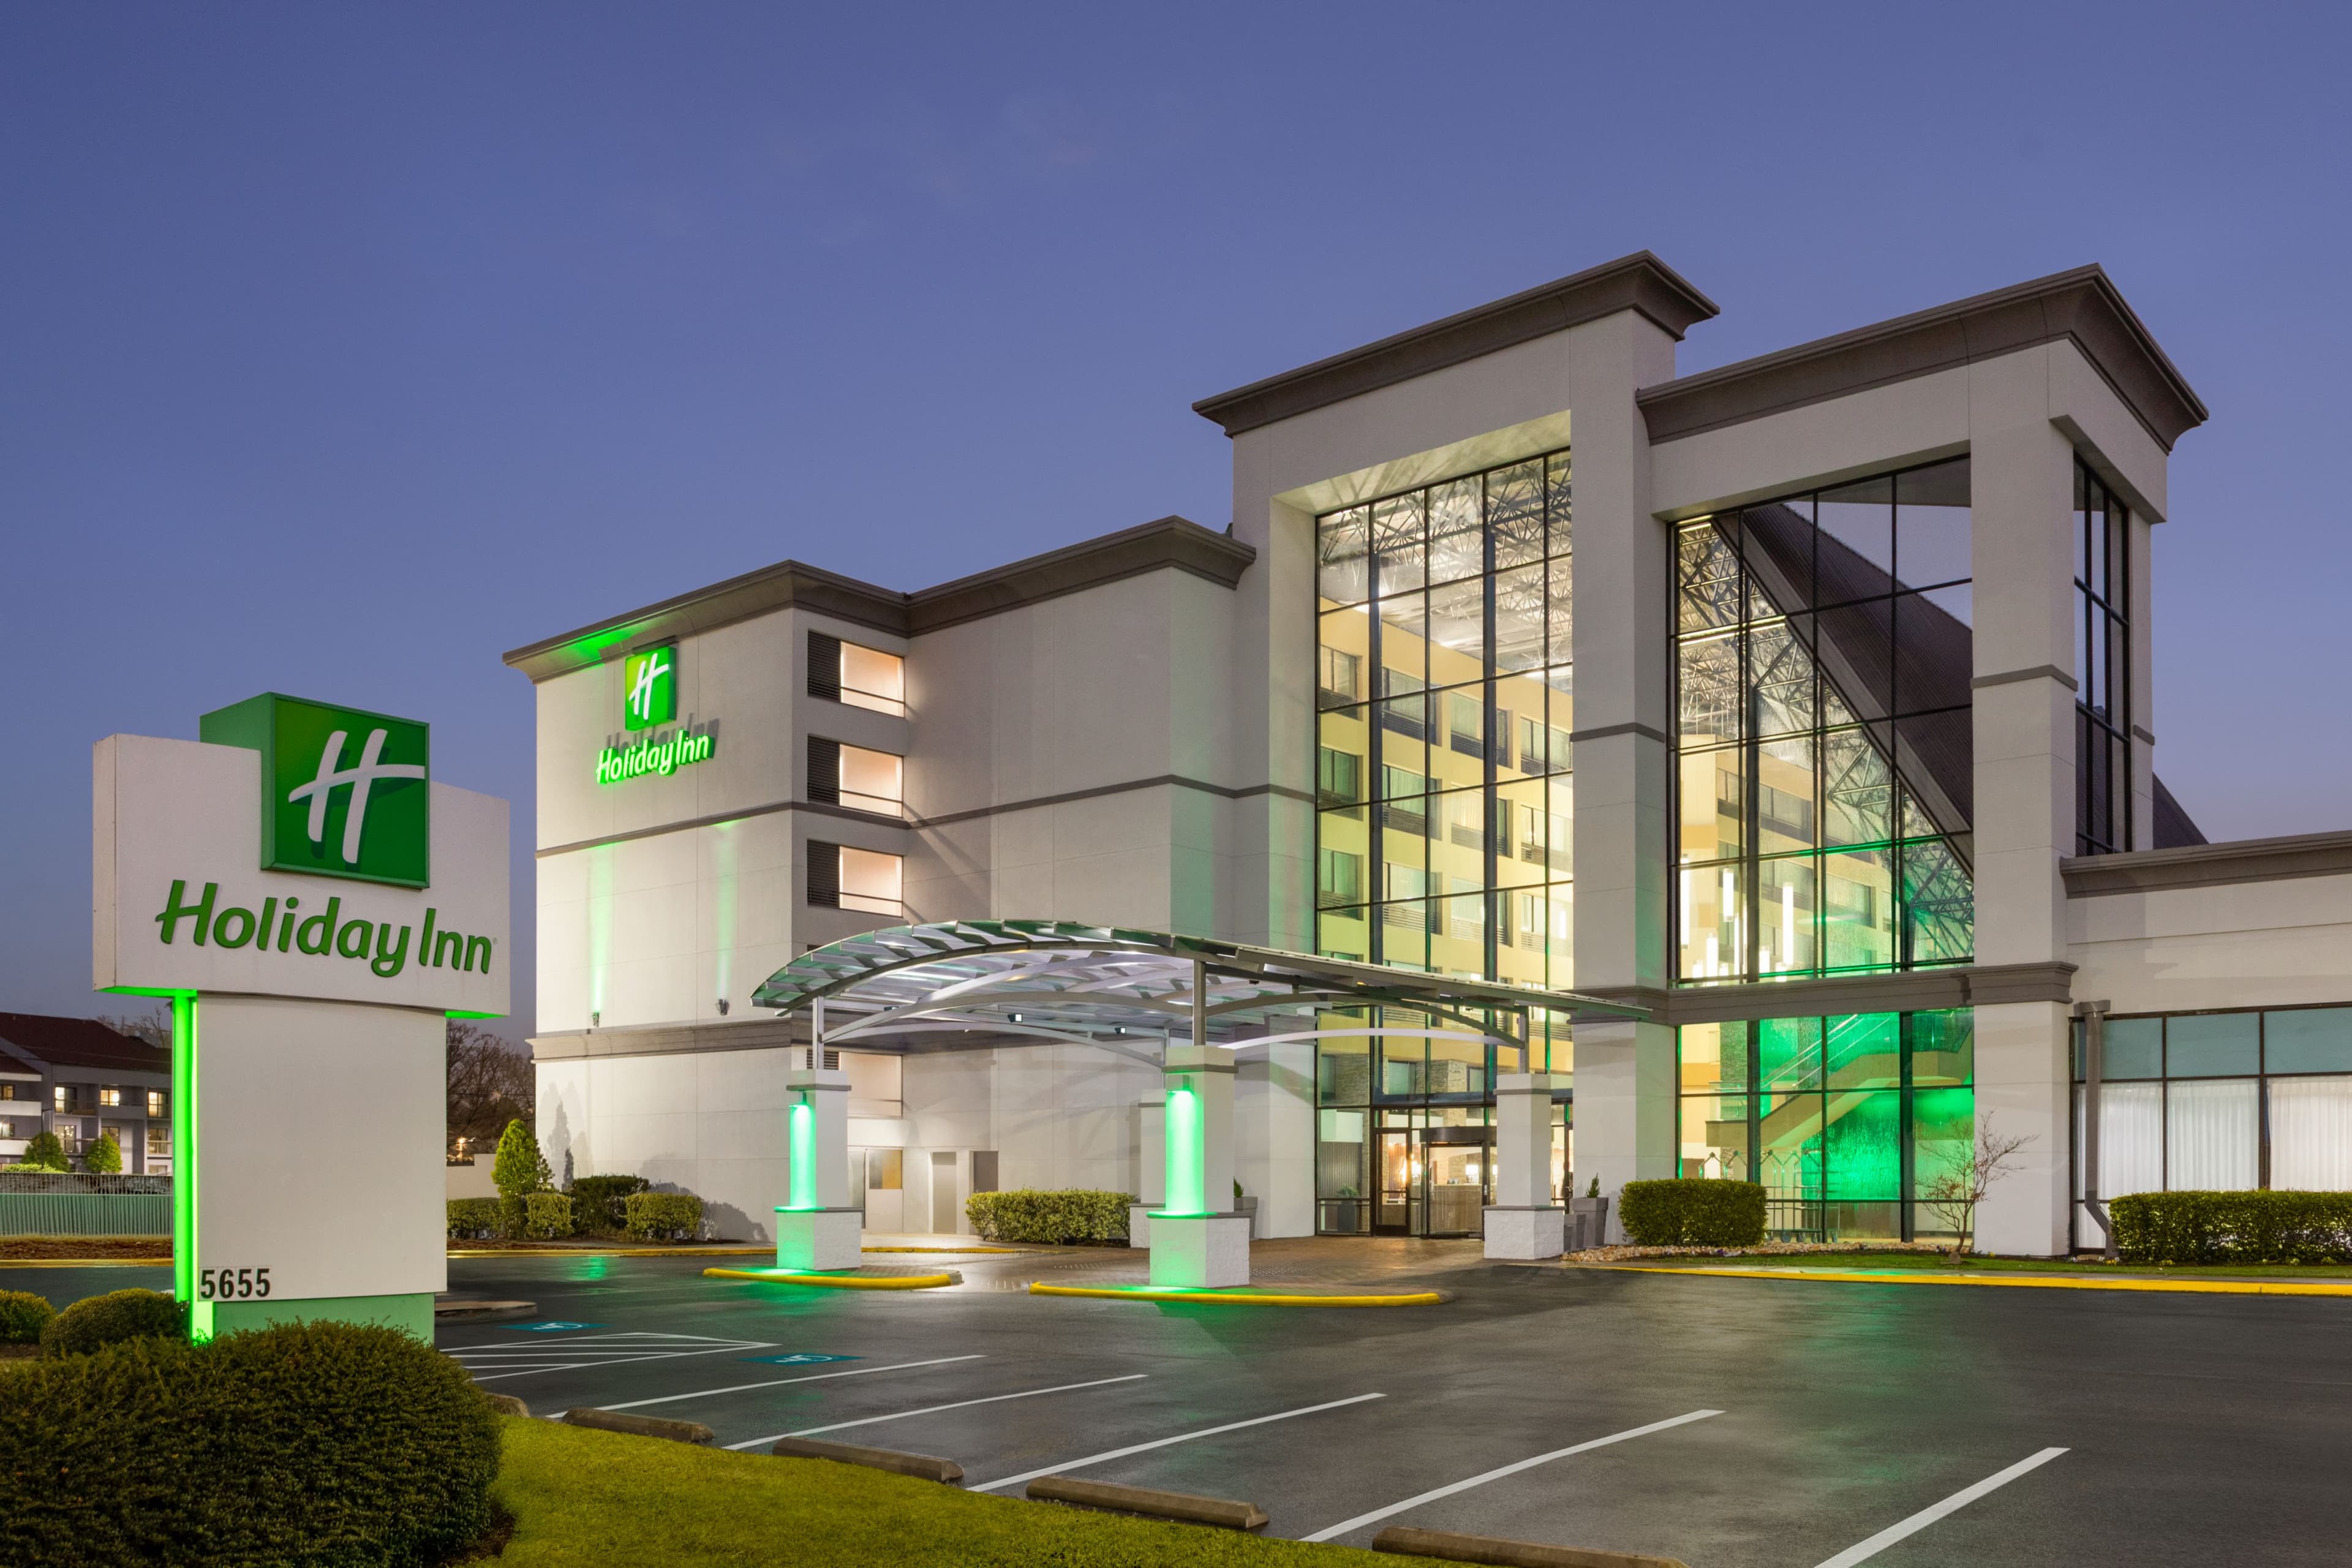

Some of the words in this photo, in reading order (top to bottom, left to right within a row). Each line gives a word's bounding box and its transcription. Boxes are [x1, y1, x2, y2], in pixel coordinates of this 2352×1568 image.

[628, 653, 669, 720] H
[595, 738, 674, 784] Holiday
[676, 729, 710, 765] Inn
[288, 728, 425, 864] H
[155, 880, 411, 978] Holiday
[418, 908, 492, 974] Inn
[200, 1268, 271, 1298] 5655
